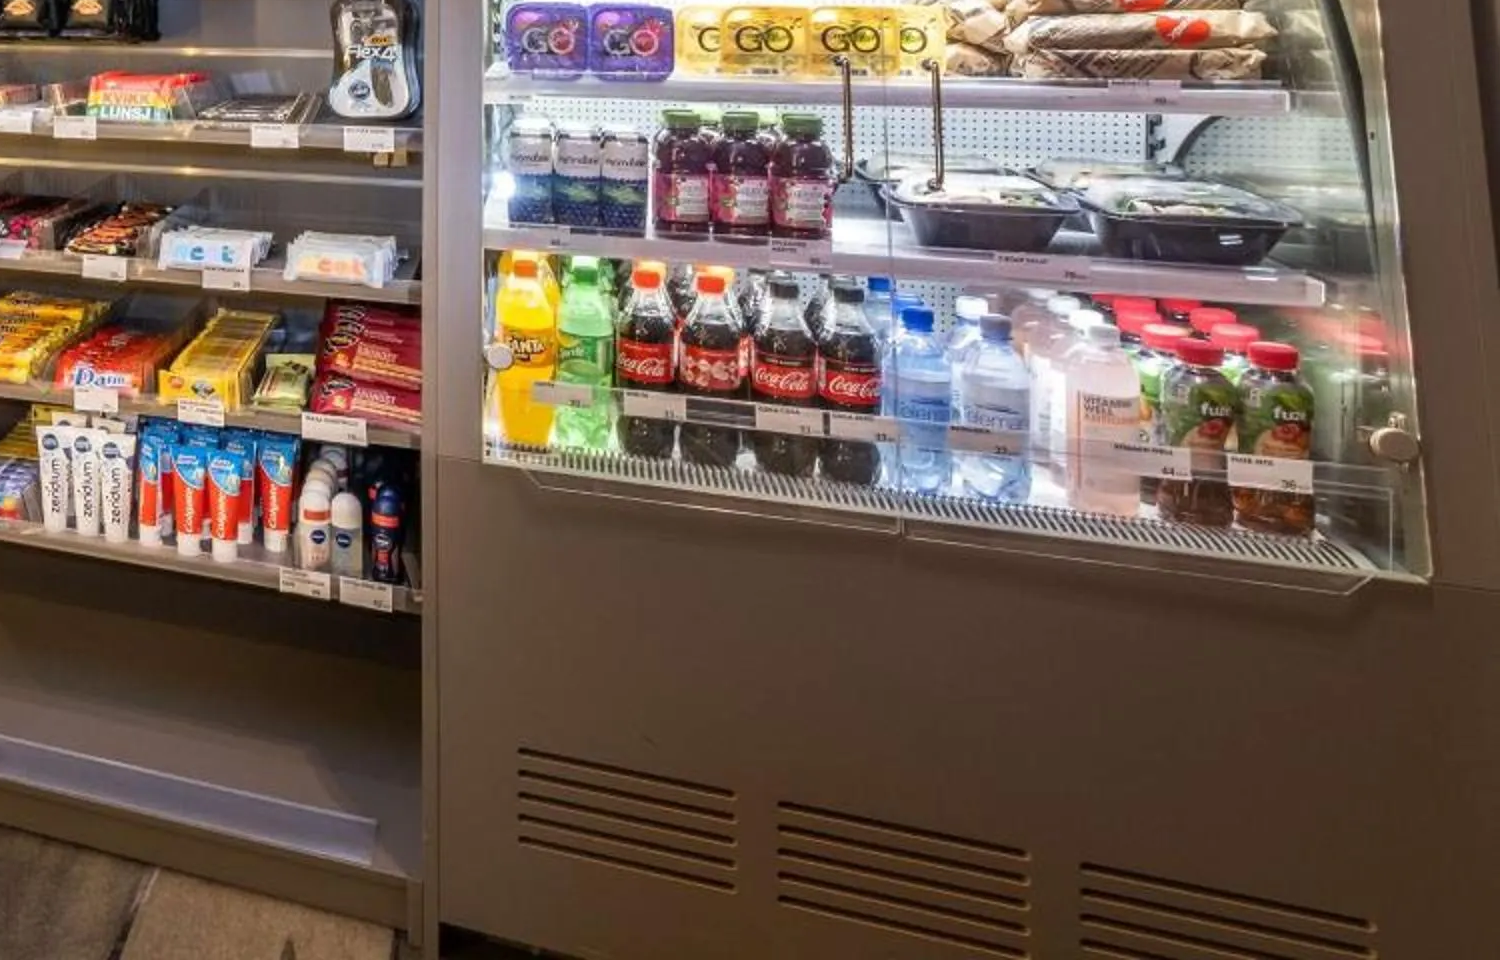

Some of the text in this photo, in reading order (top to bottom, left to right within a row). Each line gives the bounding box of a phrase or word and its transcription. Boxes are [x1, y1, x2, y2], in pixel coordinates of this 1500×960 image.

[522, 26, 576, 56] GO
[603, 27, 659, 57] GO
[735, 25, 794, 53] GO
[821, 25, 881, 53] GO
[900, 26, 927, 54] O
[100, 105, 152, 121] LUNSJ
[75, 368, 125, 386] Daim
[755, 367, 810, 391] Coca-Cola
[1082, 396, 1133, 408] VITAMIN
[49, 458, 61, 514] zendium
[82, 461, 93, 518] zendium
[110, 467, 121, 524] zendium
